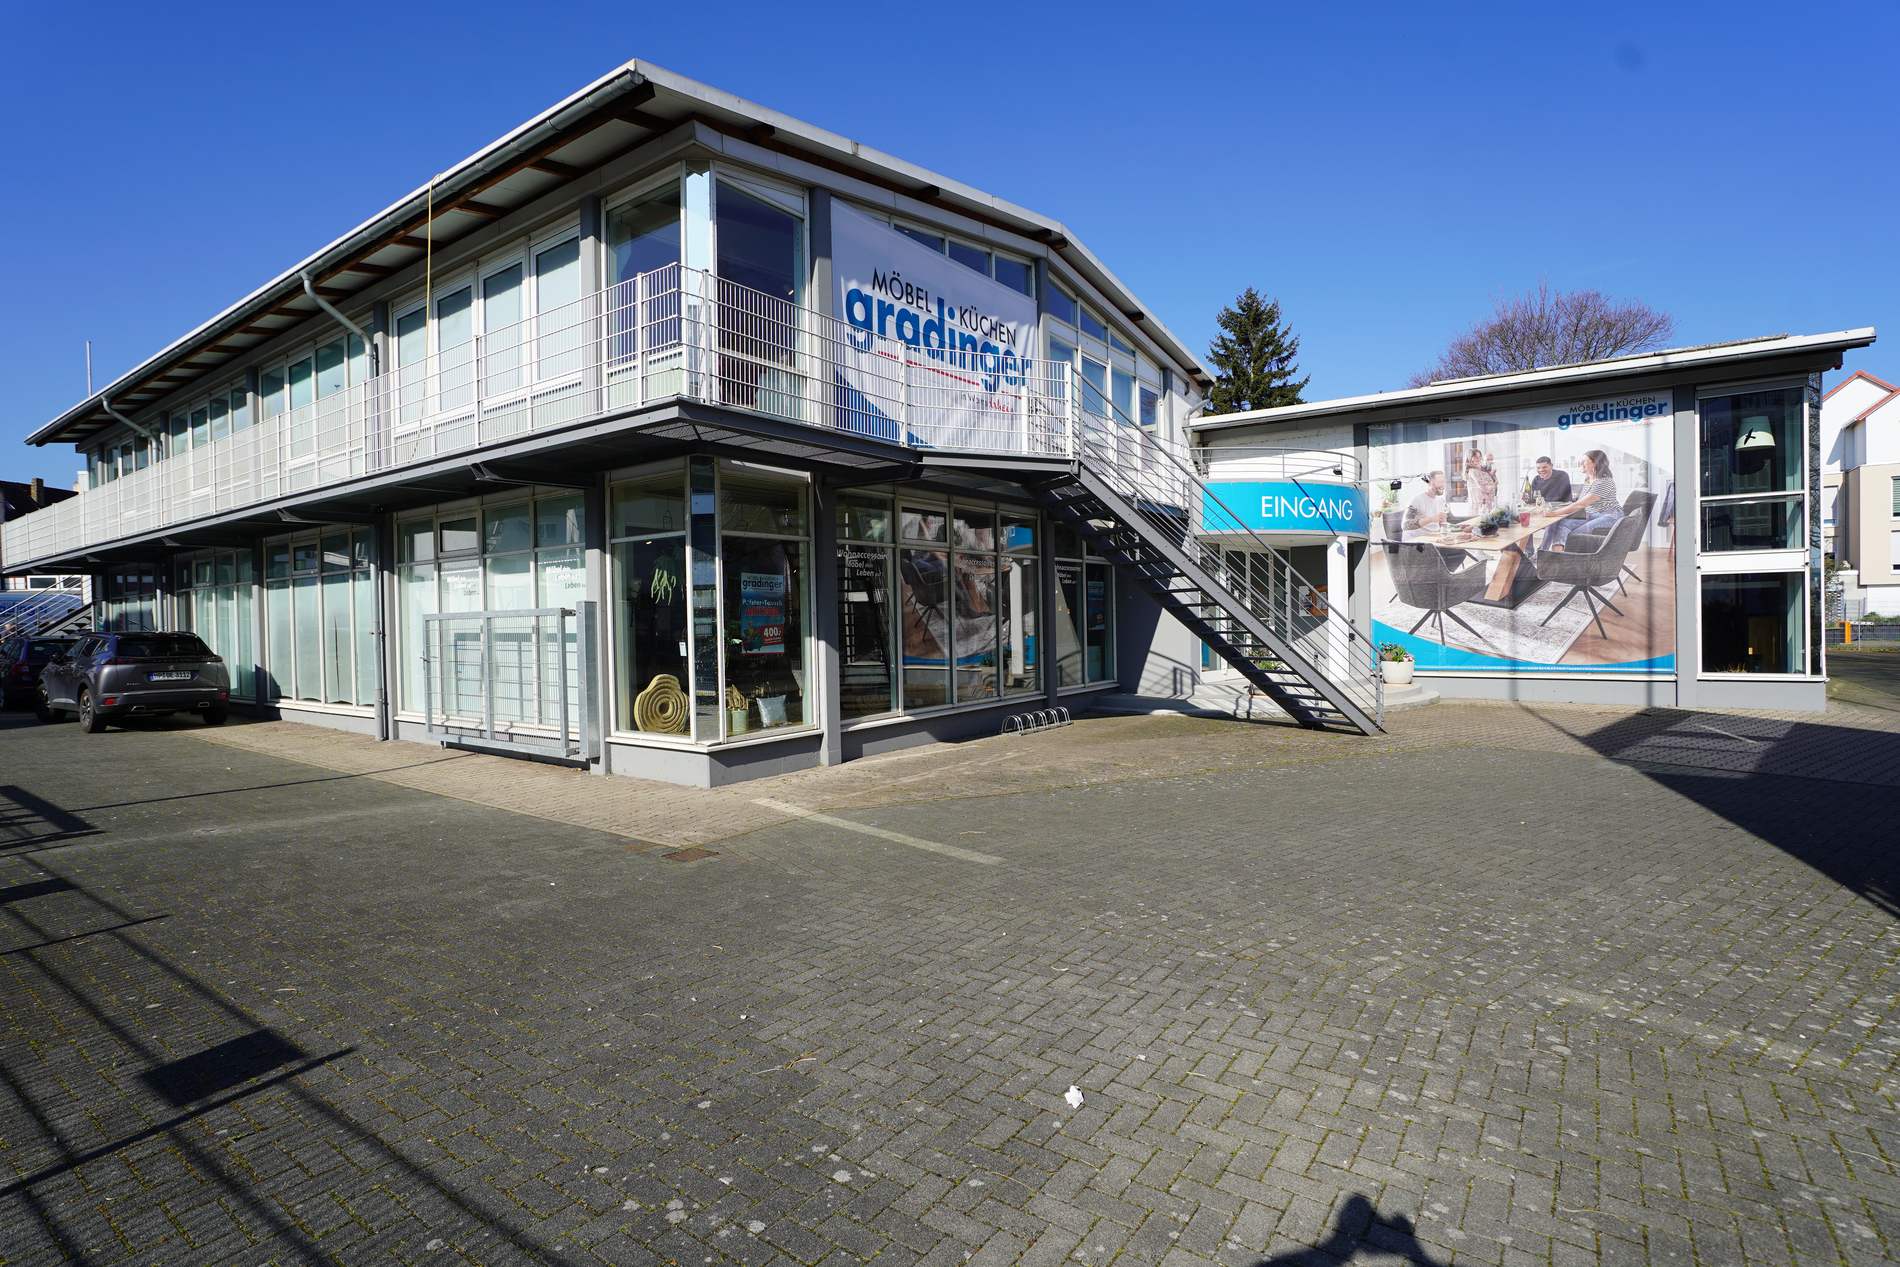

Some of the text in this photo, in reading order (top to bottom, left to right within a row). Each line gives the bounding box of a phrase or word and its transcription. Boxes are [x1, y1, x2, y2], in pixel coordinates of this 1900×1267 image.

[872, 267, 1017, 346] MÖBEL KÜCHEN
[1558, 402, 1667, 429] gradinger
[1569, 395, 1656, 414] MÖBEL KÜCHEN
[1262, 496, 1353, 521] EINGANG
